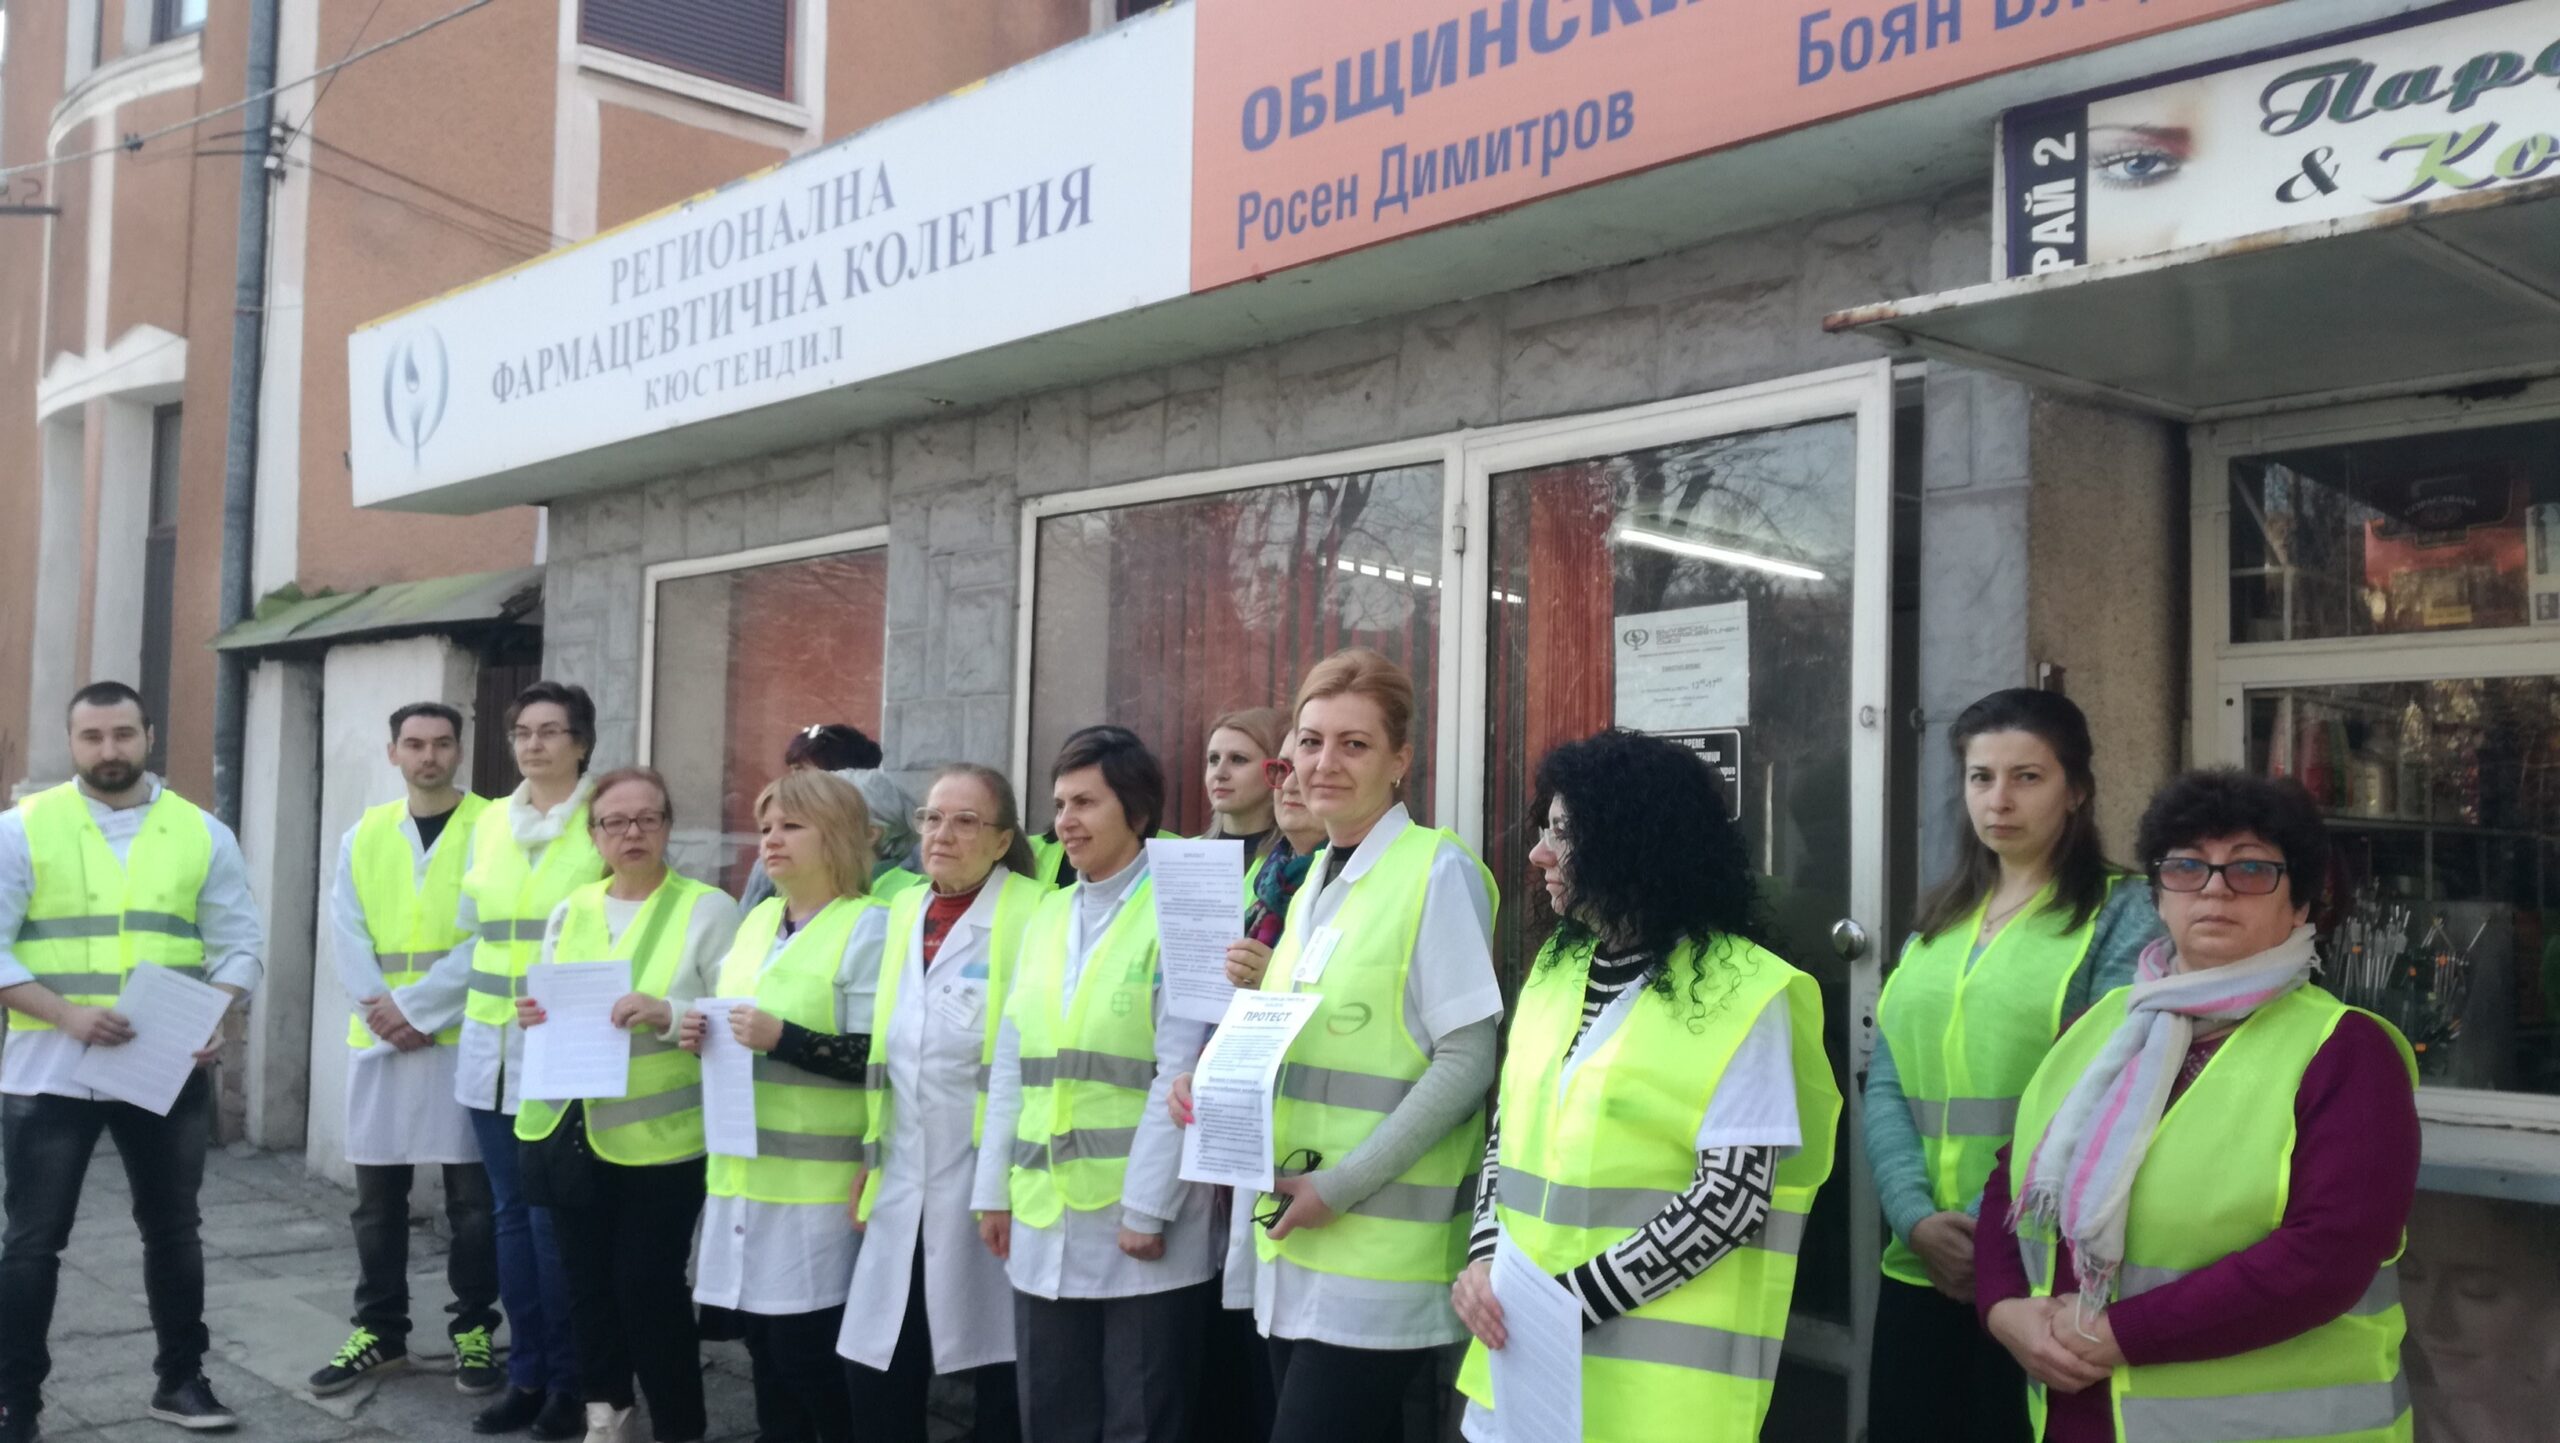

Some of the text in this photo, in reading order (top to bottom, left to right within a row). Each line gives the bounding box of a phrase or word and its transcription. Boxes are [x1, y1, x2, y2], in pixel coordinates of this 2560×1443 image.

[1797, 0, 1962, 86] Боян
[1236, 90, 1636, 250] Росен Димитров
[2032, 131, 2076, 167] 2
[2274, 145, 2341, 203] &
[610, 160, 896, 306] РЕГИОНАЛНА
[491, 163, 1095, 404] ФАРМАЦЕВТИЧНА КОЛЕГИЯ
[644, 325, 845, 411] КЮСТЕНДИЛ
[1243, 1010, 1292, 1022] ПРОТЕСТ
